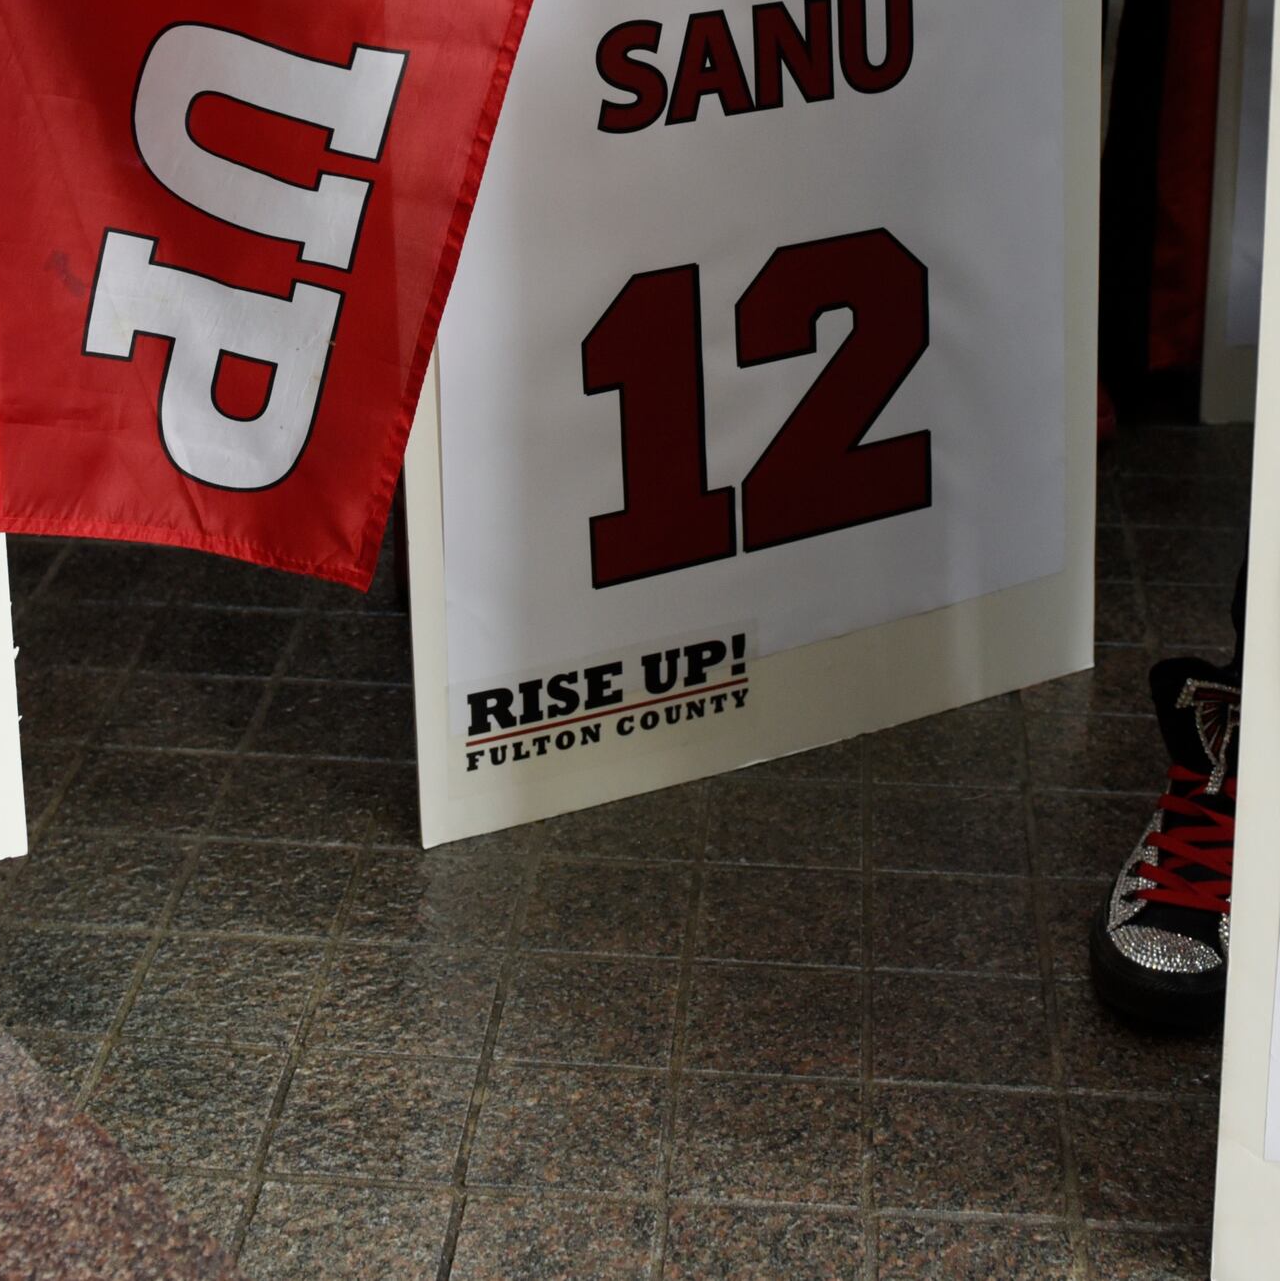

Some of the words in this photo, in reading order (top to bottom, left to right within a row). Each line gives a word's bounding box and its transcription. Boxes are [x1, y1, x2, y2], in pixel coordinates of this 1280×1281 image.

[81, 20, 411, 493] UP
[581, 227, 933, 590] 12
[466, 660, 623, 737] RISE
[640, 633, 747, 695] UP!
[466, 723, 602, 773] FULTON
[616, 688, 750, 737] COUNTY
